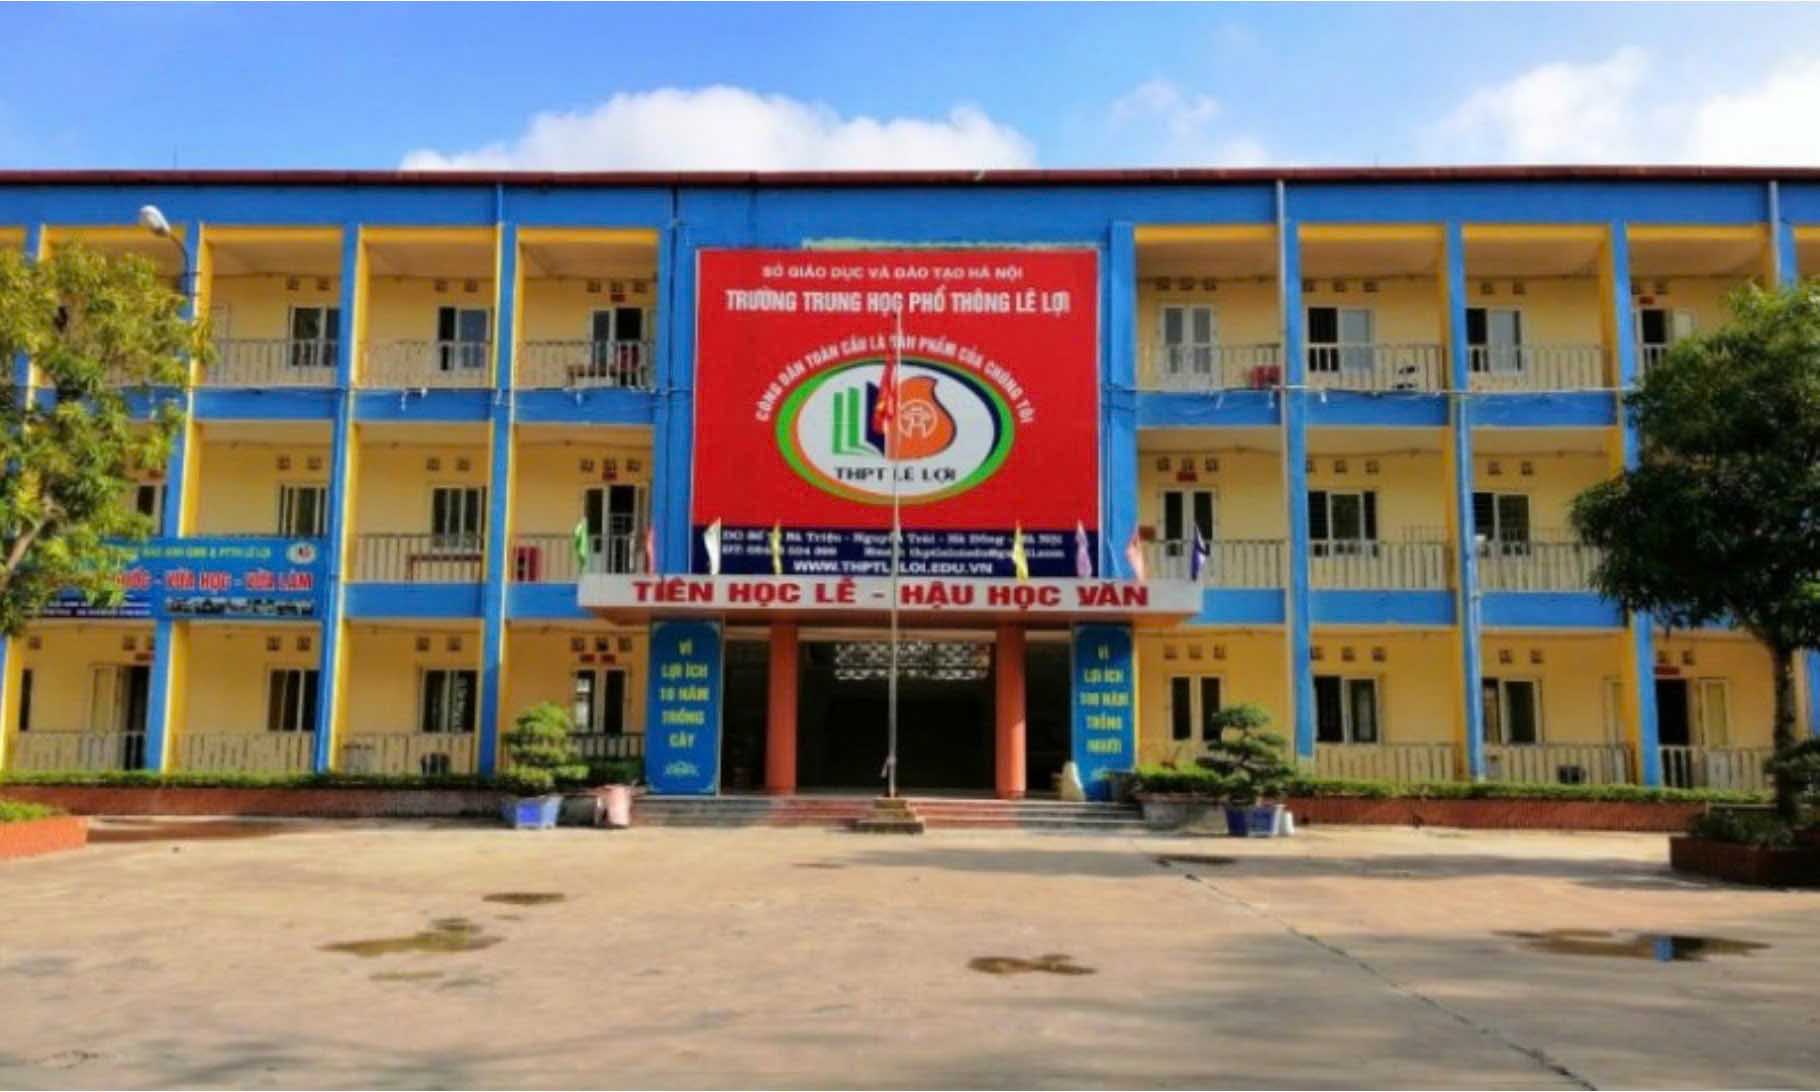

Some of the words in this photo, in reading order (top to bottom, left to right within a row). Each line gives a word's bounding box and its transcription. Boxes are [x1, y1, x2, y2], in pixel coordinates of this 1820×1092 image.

[788, 264, 826, 278] GIÁO
[831, 265, 864, 281] DỤC
[932, 265, 966, 281] TẠO
[995, 263, 1023, 282] NỘI
[725, 285, 798, 312] TRƯỜNG
[802, 290, 862, 313] TRUNG
[867, 290, 903, 318] HỌC
[908, 284, 947, 313] PHỔ
[950, 287, 1011, 313] THÔNG
[1014, 287, 1036, 313] LÊ
[1041, 289, 1071, 317] LỢI
[835, 465, 888, 480] THPT
[922, 465, 956, 483] LỢI
[793, 560, 993, 574] WWW.THPTLLOI.EDU.VN
[633, 578, 714, 603] TIÊN
[728, 583, 801, 606] HỌC
[815, 576, 857, 604] LỄ
[901, 581, 975, 609] HẬU
[987, 584, 1061, 609] HỌC
[1077, 582, 1148, 607] VĂN
